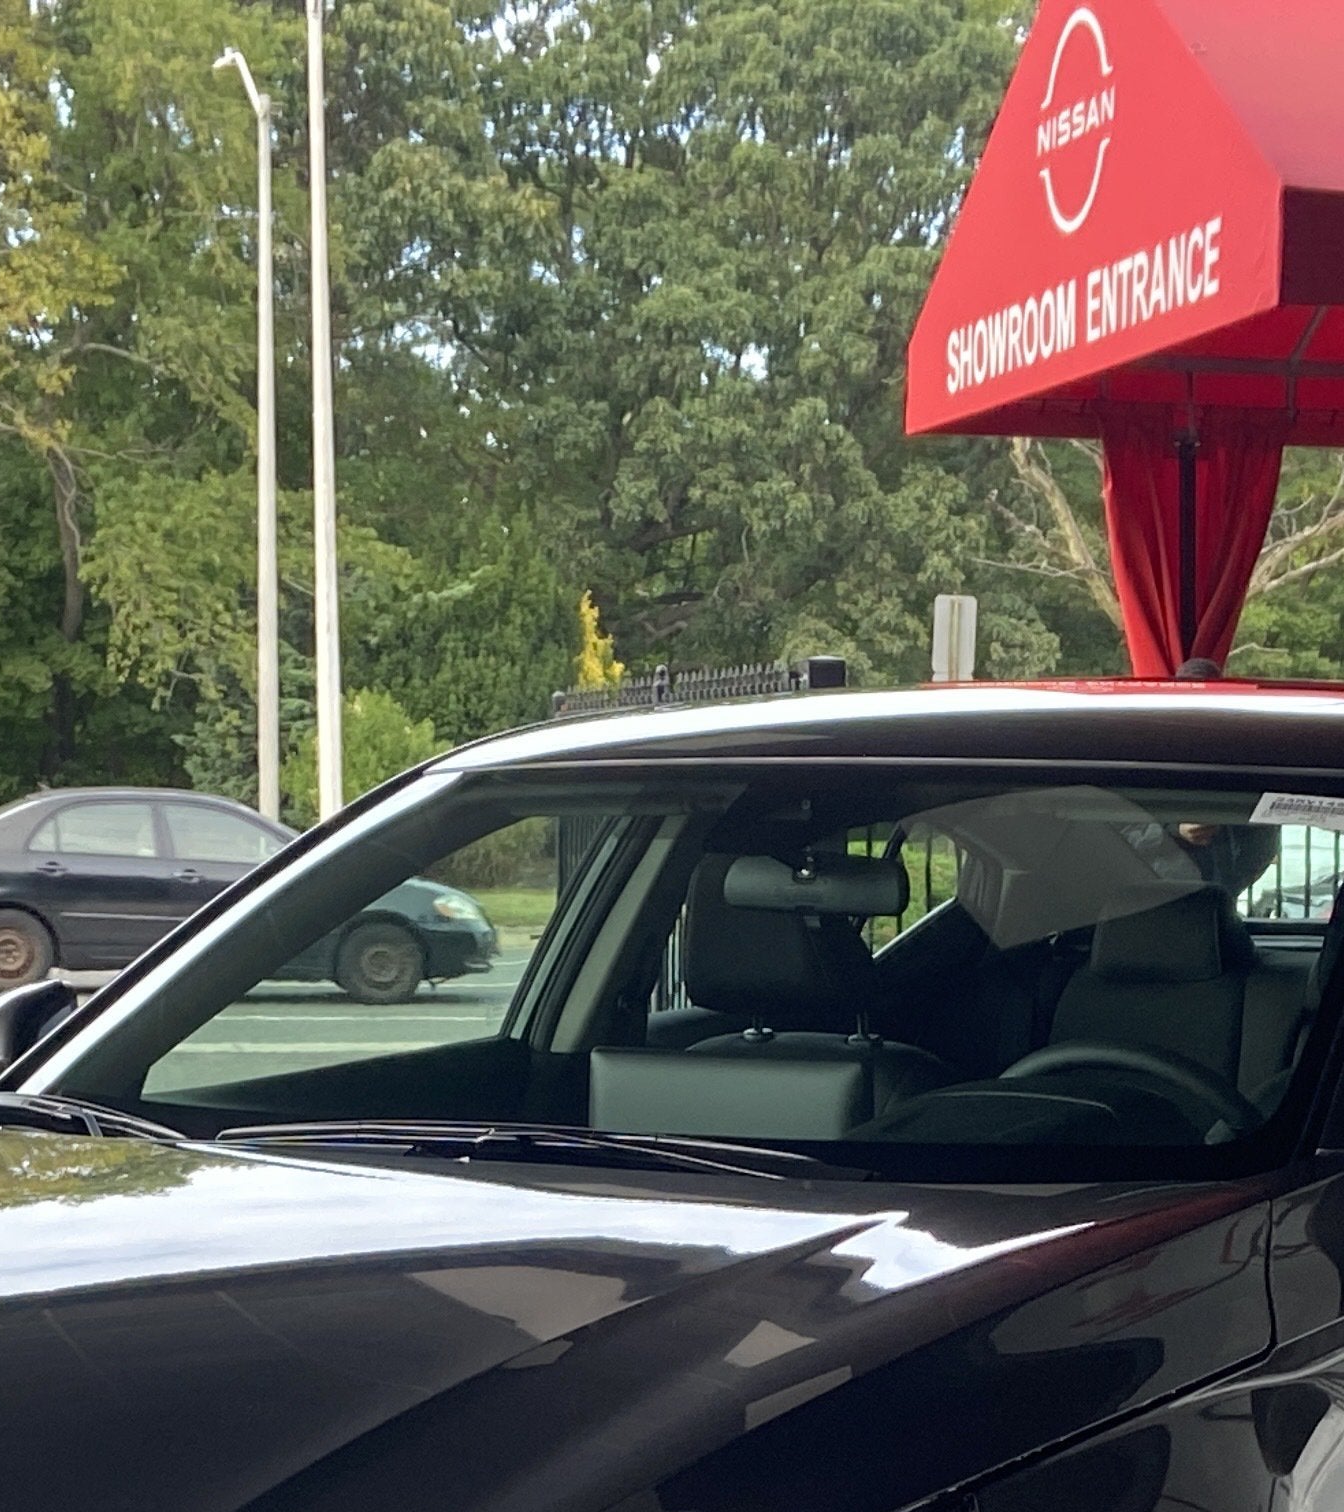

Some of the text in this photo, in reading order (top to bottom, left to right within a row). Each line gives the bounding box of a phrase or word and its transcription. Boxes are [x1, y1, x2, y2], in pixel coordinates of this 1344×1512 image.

[1036, 86, 1115, 156] NISSAN
[946, 215, 1222, 394] SHOWROOM ENTRANCE
